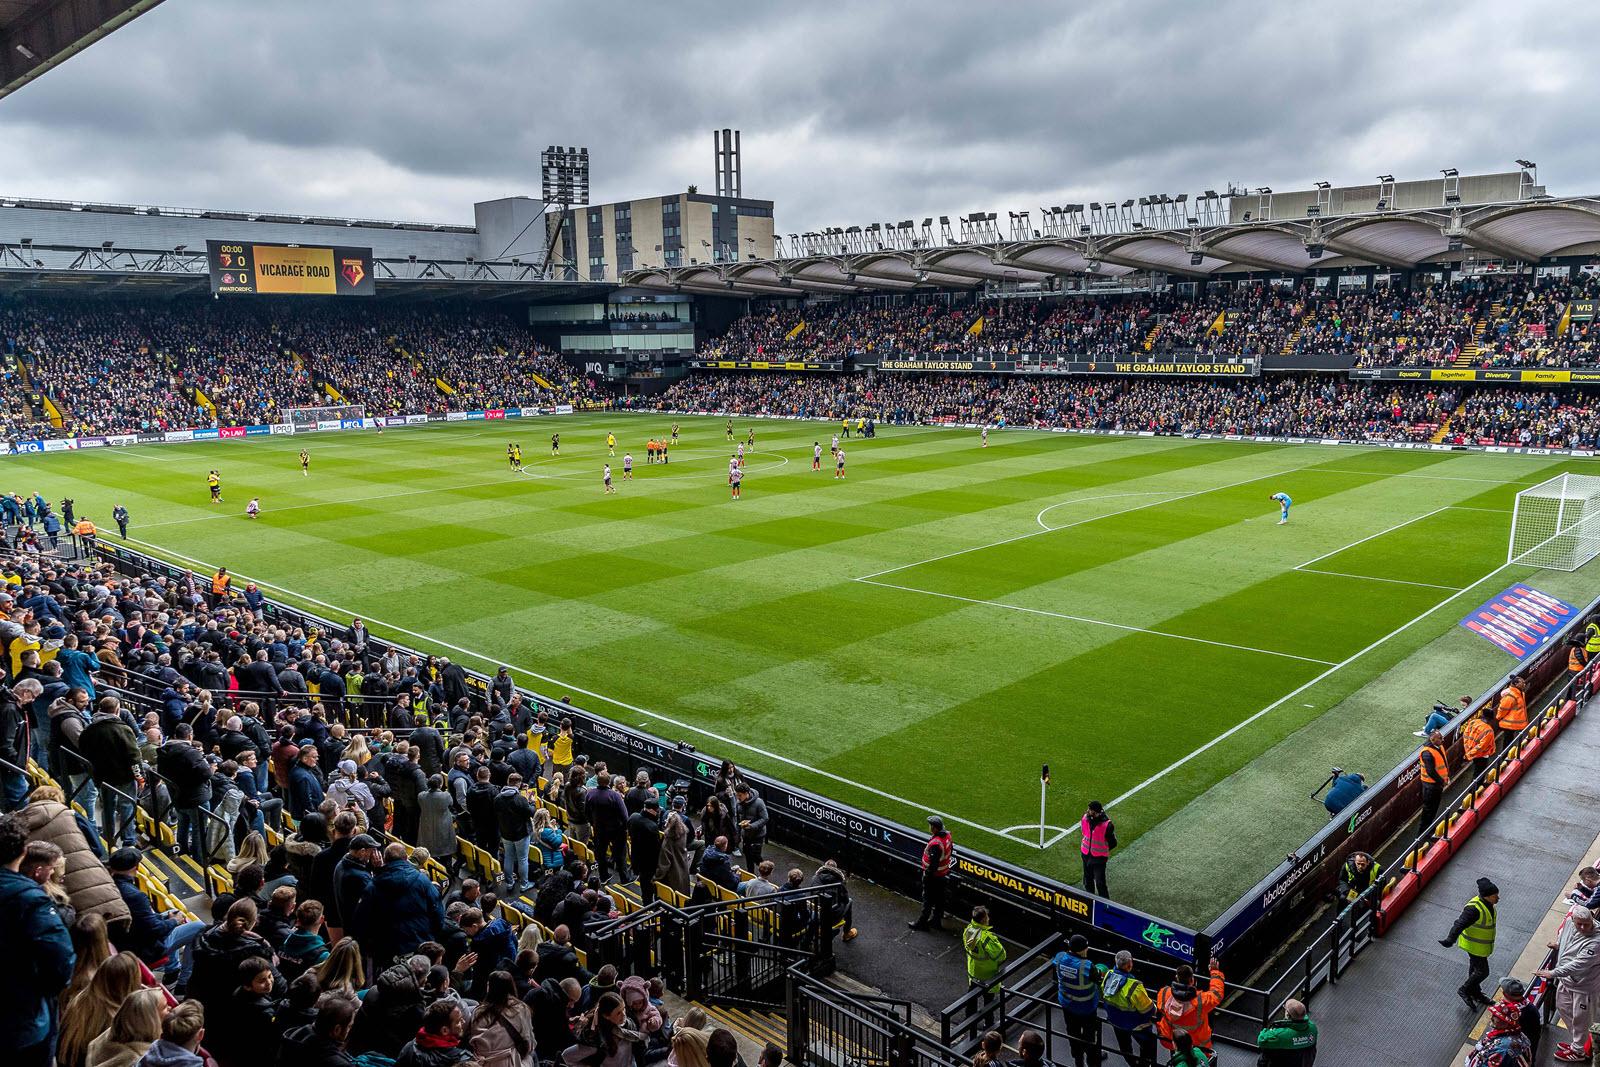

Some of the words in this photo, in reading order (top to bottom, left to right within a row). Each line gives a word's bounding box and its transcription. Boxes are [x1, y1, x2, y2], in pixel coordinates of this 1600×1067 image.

[221, 245, 243, 253] 00:00
[237, 256, 246, 267] 0
[259, 263, 304, 277] VICARAGE
[306, 265, 330, 278] ROAD
[239, 273, 248, 284] 0
[881, 361, 893, 369] THE
[894, 361, 923, 370] GRAHAM
[924, 362, 950, 370] TAYLOR
[950, 362, 973, 370] STAND
[1116, 363, 1132, 372] THE
[1133, 363, 1174, 373] GRAHAM
[1176, 363, 1211, 373] TAYLOR
[1213, 364, 1246, 374] STAND
[231, 429, 244, 437] LAW
[788, 795, 892, 843] hbclogisticsco.uk
[959, 859, 1025, 893] REGIONAL
